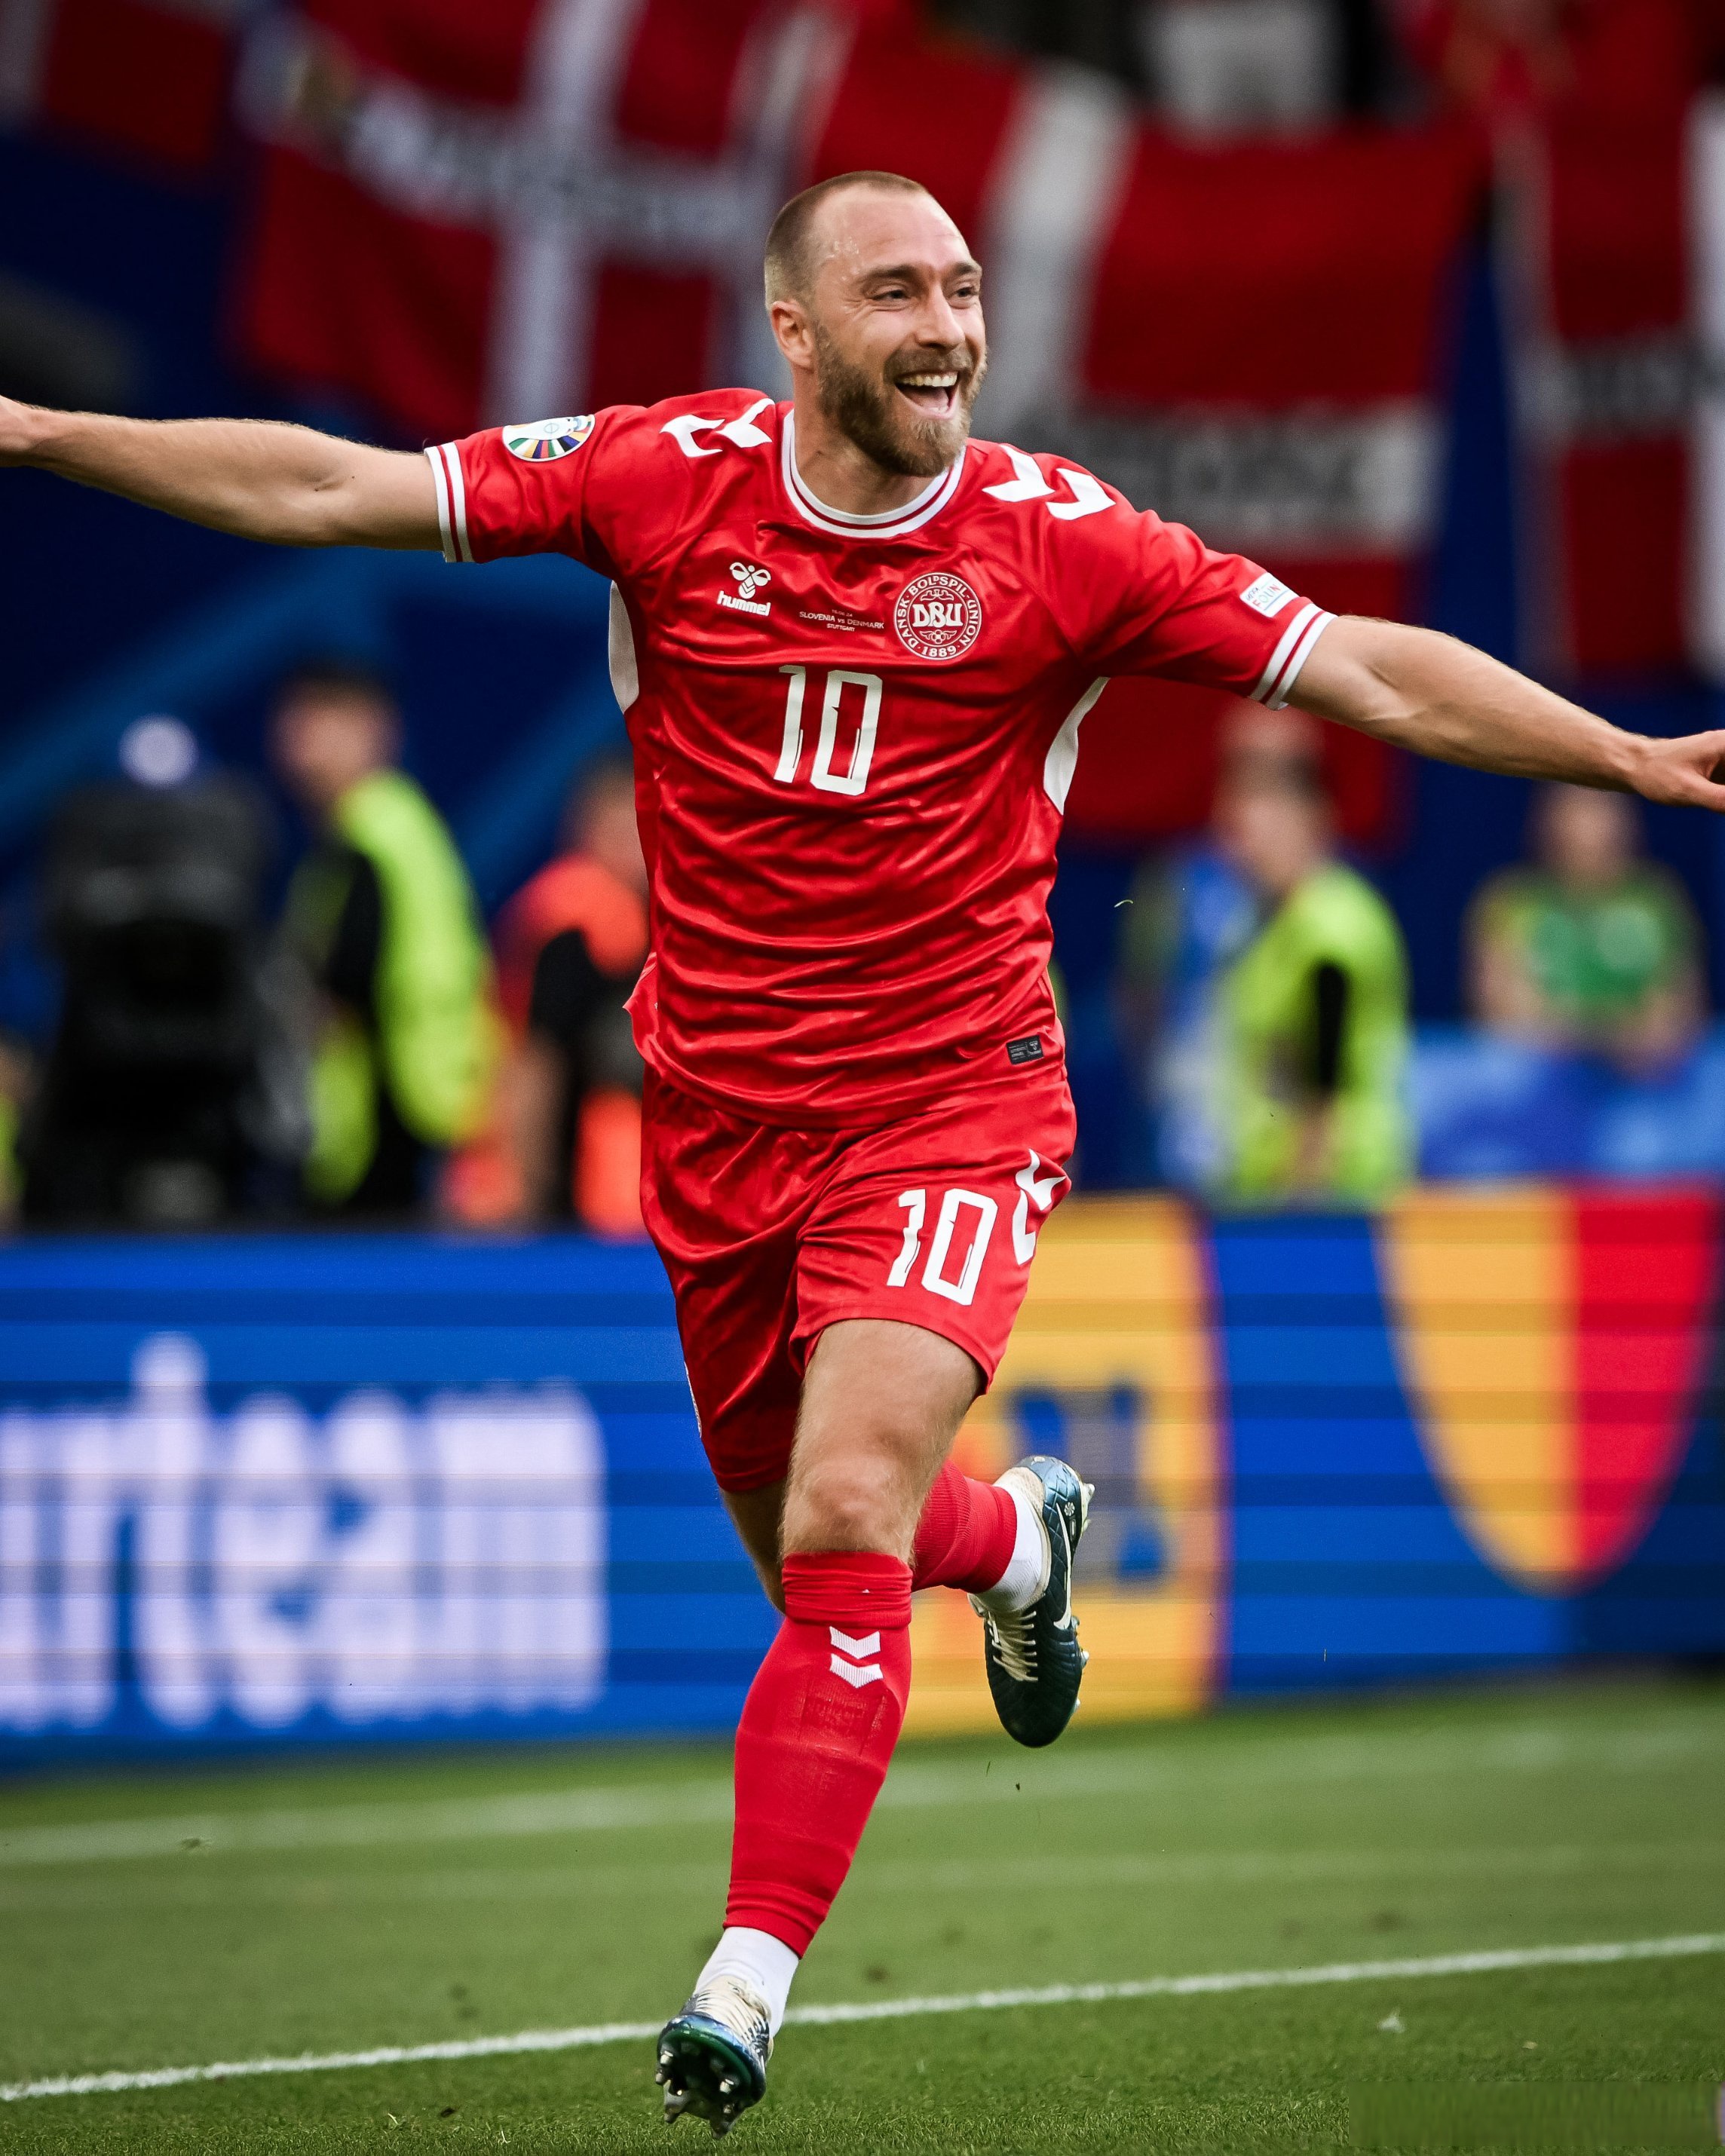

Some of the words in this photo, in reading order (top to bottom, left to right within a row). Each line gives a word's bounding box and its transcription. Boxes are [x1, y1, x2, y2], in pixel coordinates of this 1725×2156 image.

[716, 590, 771, 617] hummel
[912, 602, 964, 628] DBU
[799, 611, 835, 622] SLOVENIA
[847, 618, 884, 629] DENMARK
[826, 623, 855, 632] STUTTGART
[897, 597, 919, 648] DANSK
[921, 645, 957, 657] 1889
[774, 665, 883, 796] 10
[887, 1188, 998, 1306] 10
